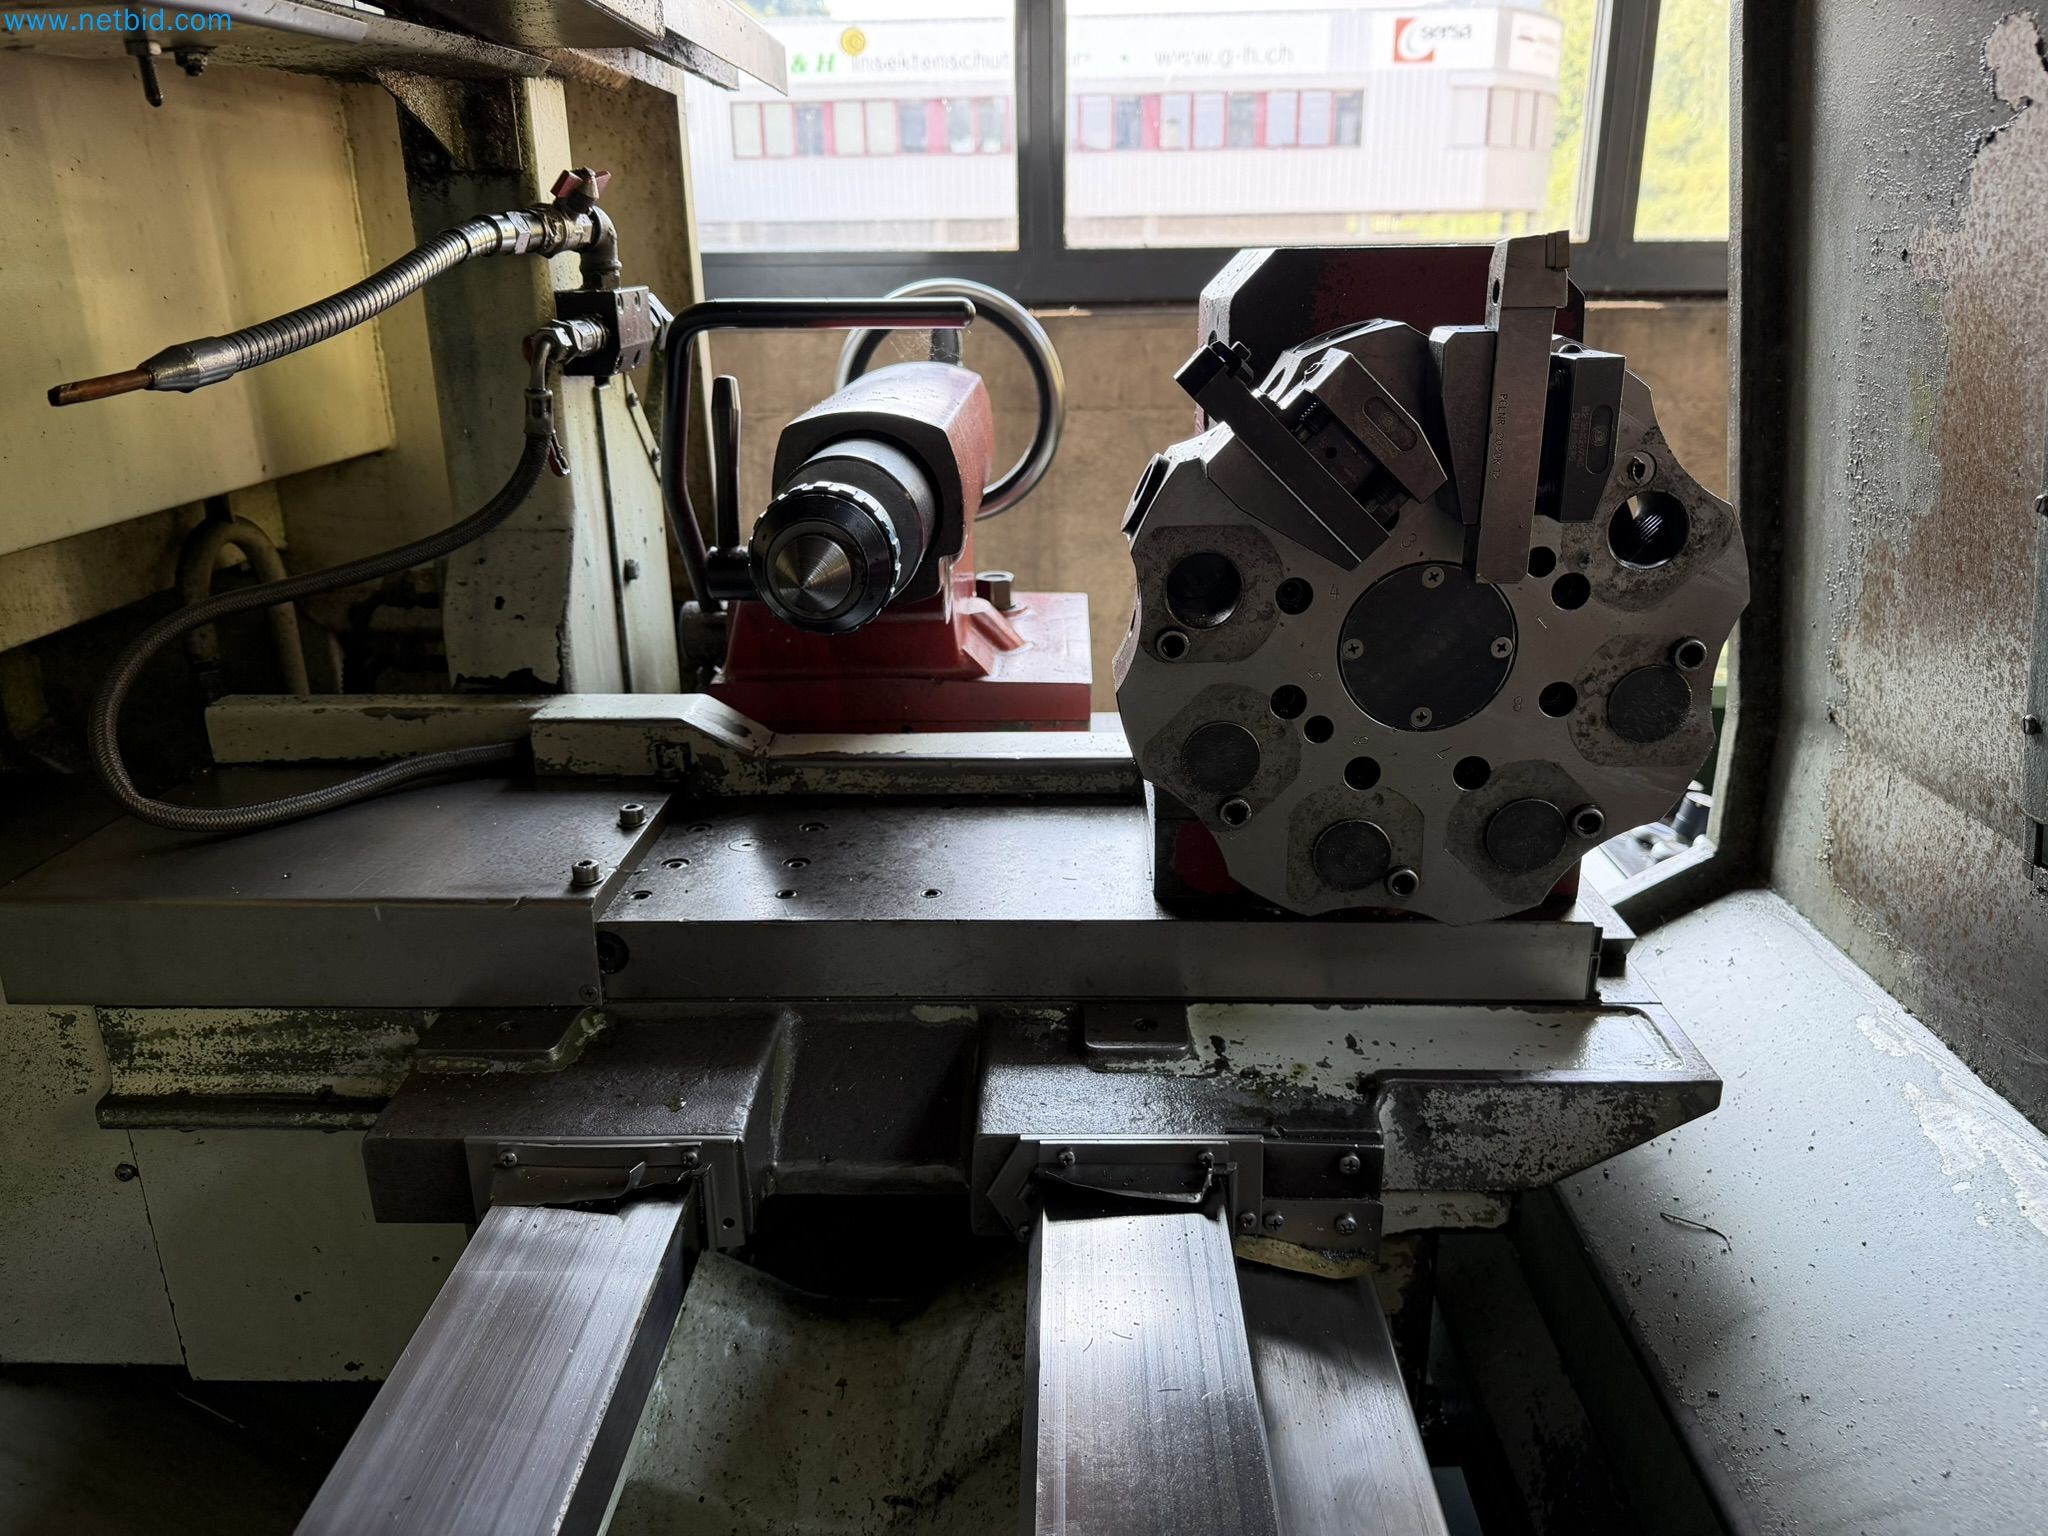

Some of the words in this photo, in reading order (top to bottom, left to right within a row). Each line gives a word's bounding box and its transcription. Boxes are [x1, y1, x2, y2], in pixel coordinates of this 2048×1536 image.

[817, 53, 837, 73] H
[850, 47, 1010, 74] Insektenschut
[1329, 583, 1340, 599] 4
[1512, 696, 1523, 712] 8
